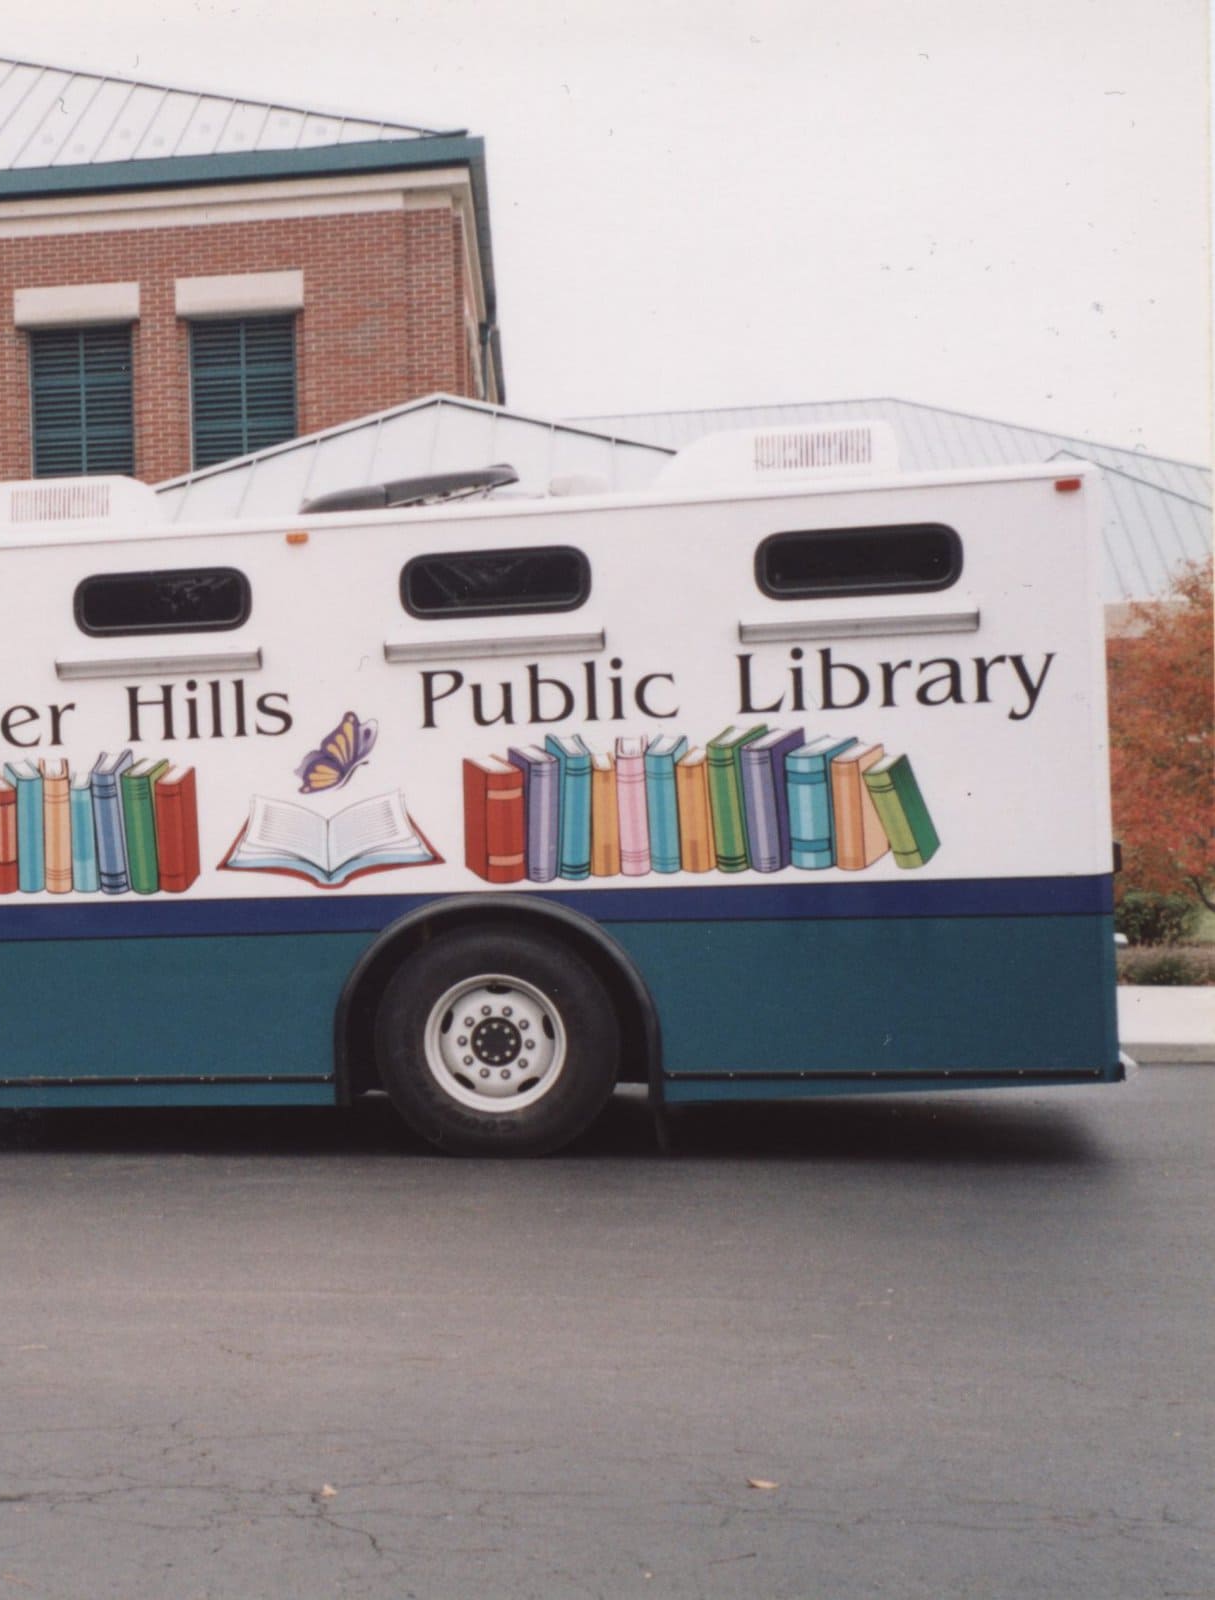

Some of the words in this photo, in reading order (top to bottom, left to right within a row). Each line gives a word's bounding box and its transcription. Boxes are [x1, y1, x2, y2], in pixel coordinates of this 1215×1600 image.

[126, 679, 293, 742] Hills
[420, 657, 679, 728] Public
[736, 647, 1056, 721] Library
